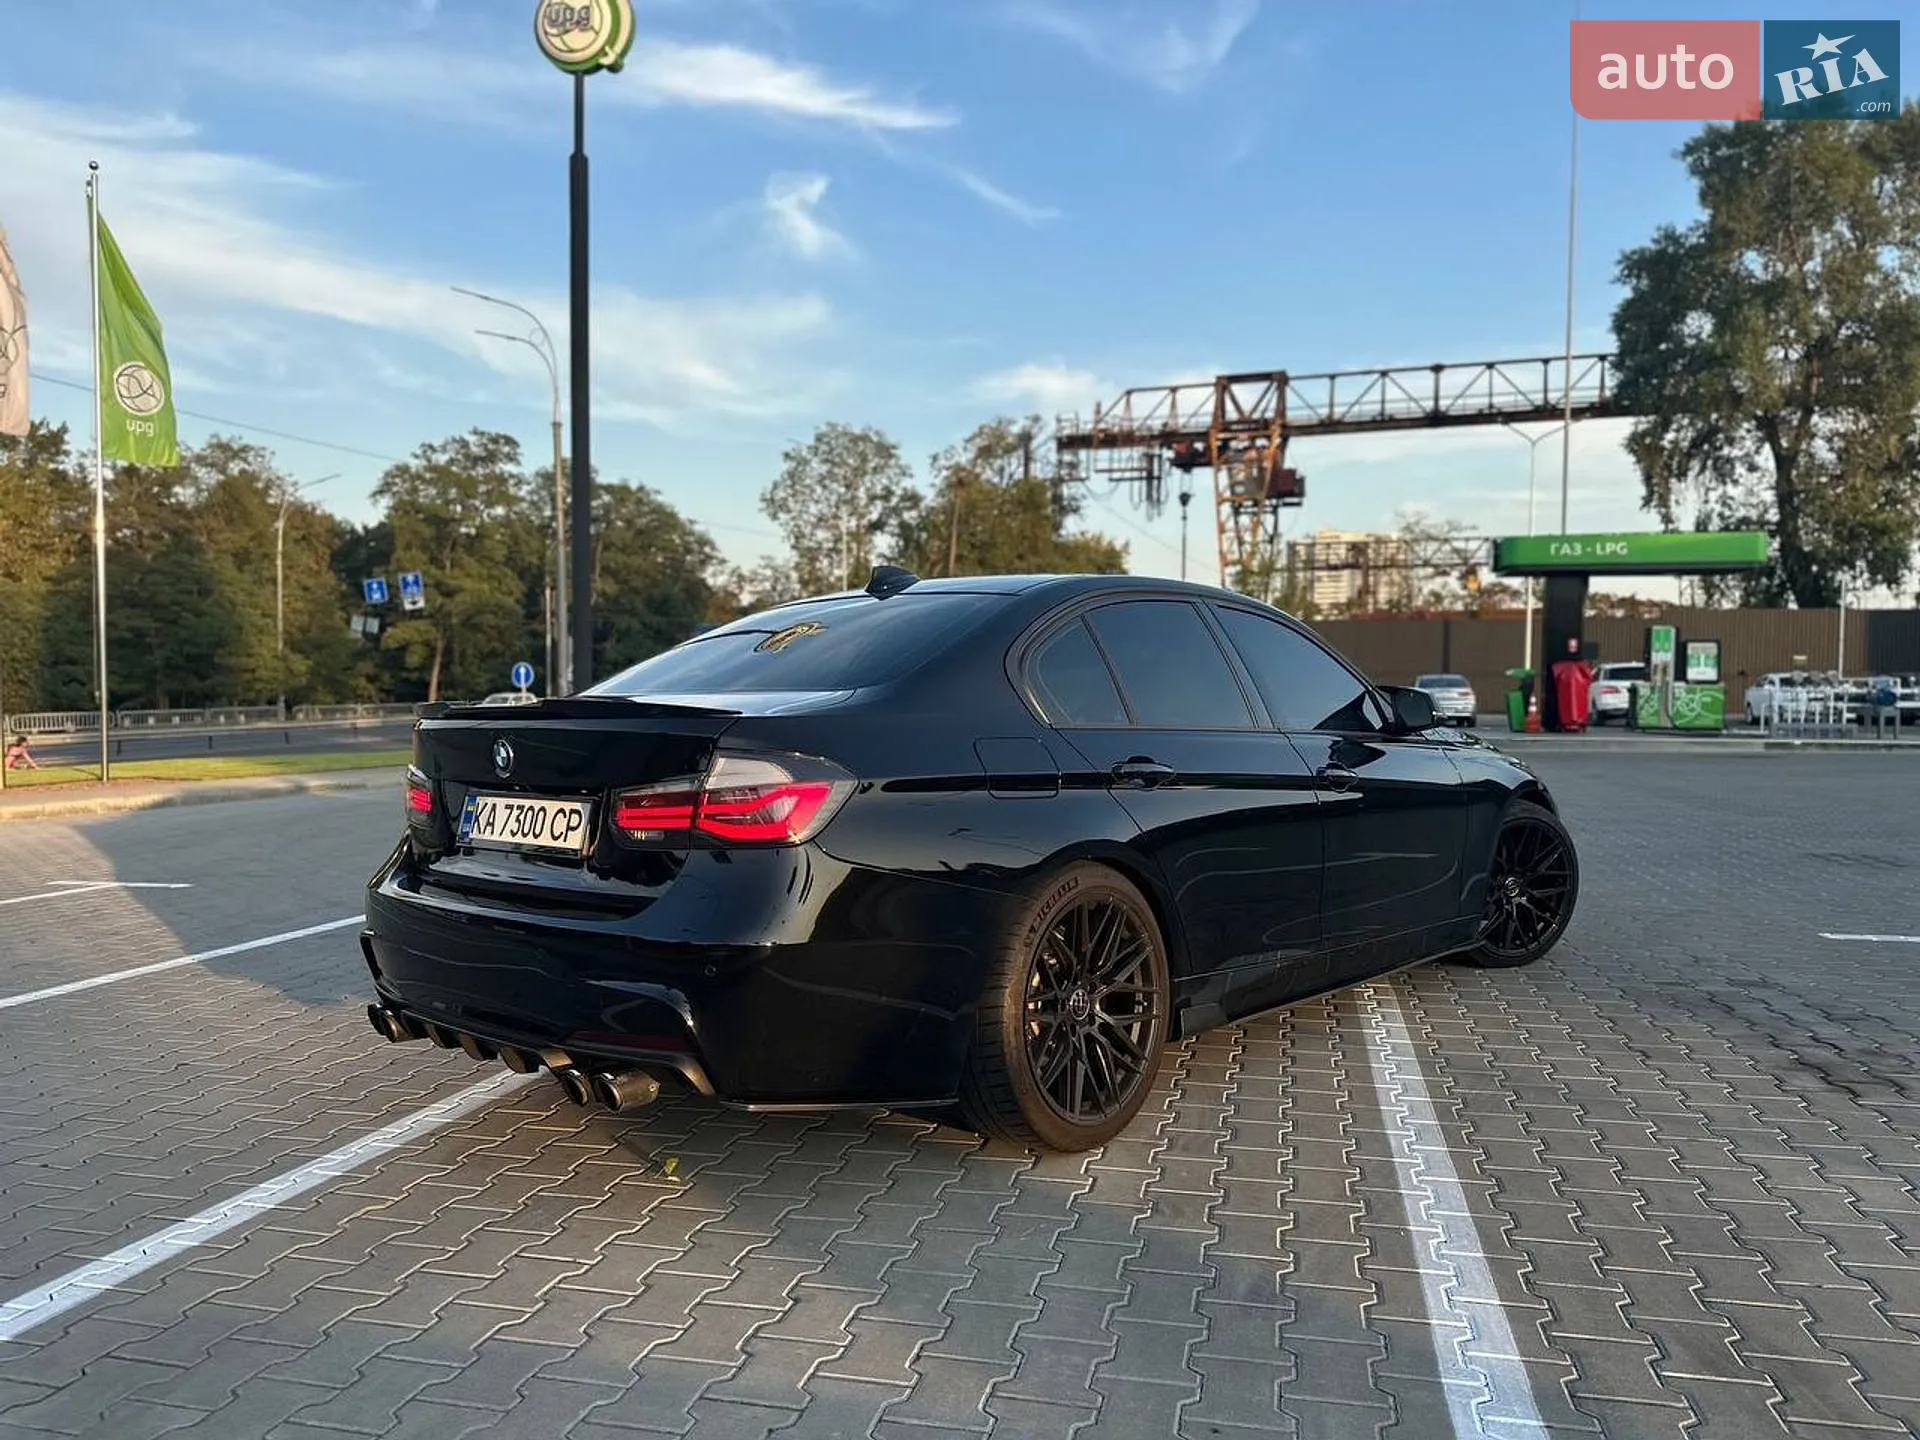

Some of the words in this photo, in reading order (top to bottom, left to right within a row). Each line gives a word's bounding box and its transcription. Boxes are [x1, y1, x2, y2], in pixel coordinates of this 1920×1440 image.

[126, 419, 154, 437] upg
[1550, 542, 1582, 556] ГАЗ
[1596, 541, 1628, 555] LPG
[472, 802, 497, 835] KA
[500, 804, 547, 839] 7300
[550, 808, 583, 842] CP
